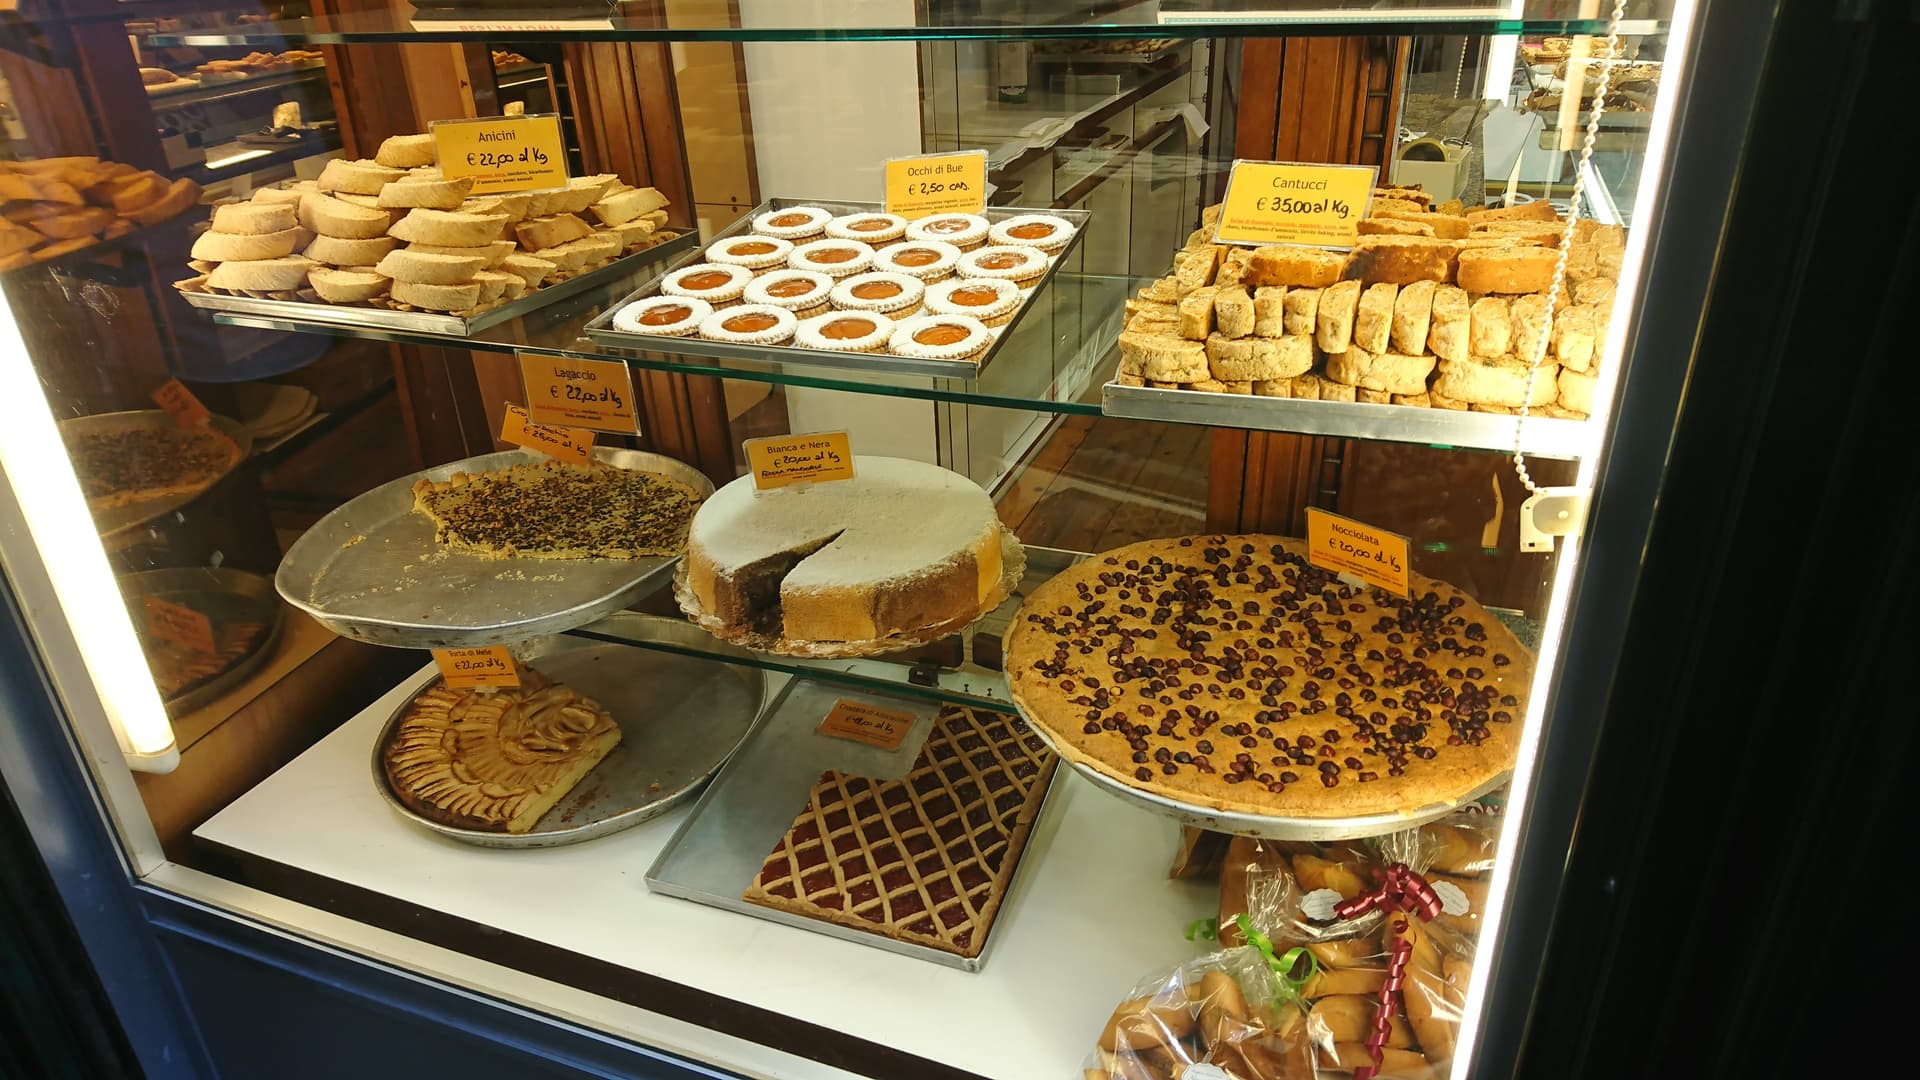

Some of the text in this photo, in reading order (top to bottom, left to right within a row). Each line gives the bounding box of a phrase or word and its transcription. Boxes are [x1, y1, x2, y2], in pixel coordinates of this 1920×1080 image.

[478, 129, 516, 143] Anicini
[467, 147, 548, 168] € 22,00 al Kg
[907, 164, 963, 177] Occhi di Bue
[908, 183, 916, 195] €
[920, 182, 944, 195] 2,50
[1272, 176, 1328, 191] Cantucci
[1256, 196, 1267, 211] €
[554, 367, 596, 381] Lagaccio
[550, 385, 559, 398] €
[566, 384, 597, 403] 22,00
[599, 387, 608, 402] al
[767, 444, 798, 454] Bianca
[808, 441, 831, 449] Nera
[774, 459, 782, 468] €
[814, 451, 824, 460] al
[1332, 523, 1379, 546] Nocciolata
[1329, 537, 1336, 549] €
[1339, 540, 1370, 559] 20,00
